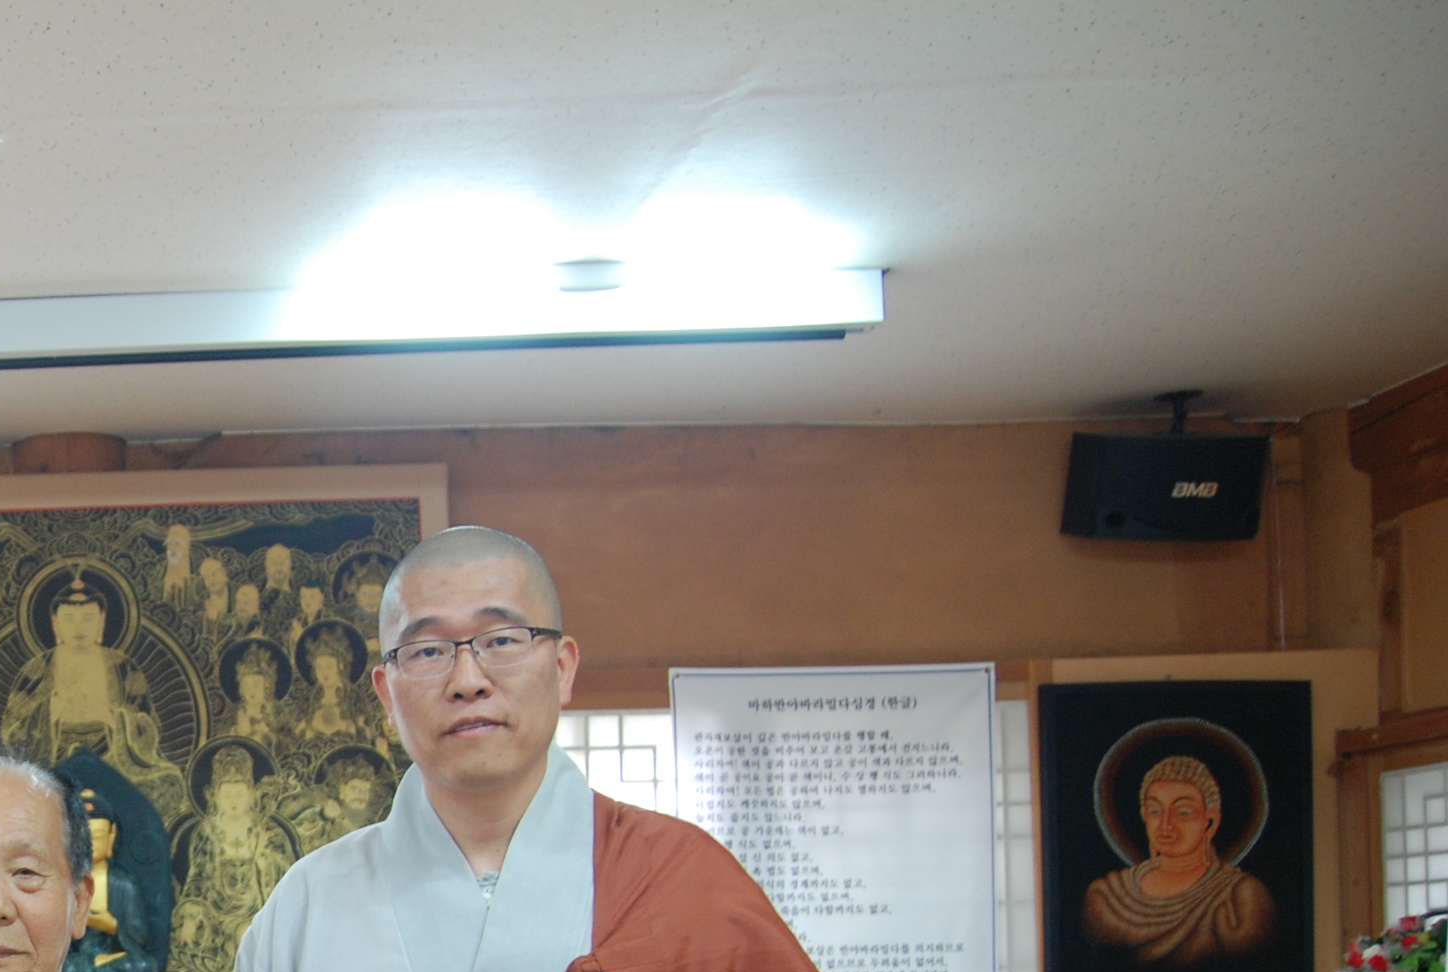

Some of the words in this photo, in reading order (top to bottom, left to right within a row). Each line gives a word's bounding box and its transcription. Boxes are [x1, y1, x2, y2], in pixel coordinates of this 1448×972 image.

[1171, 482, 1219, 498] BMB
[748, 697, 875, 711] 마하반야바라밀다심경
[882, 695, 917, 709] (한글)
